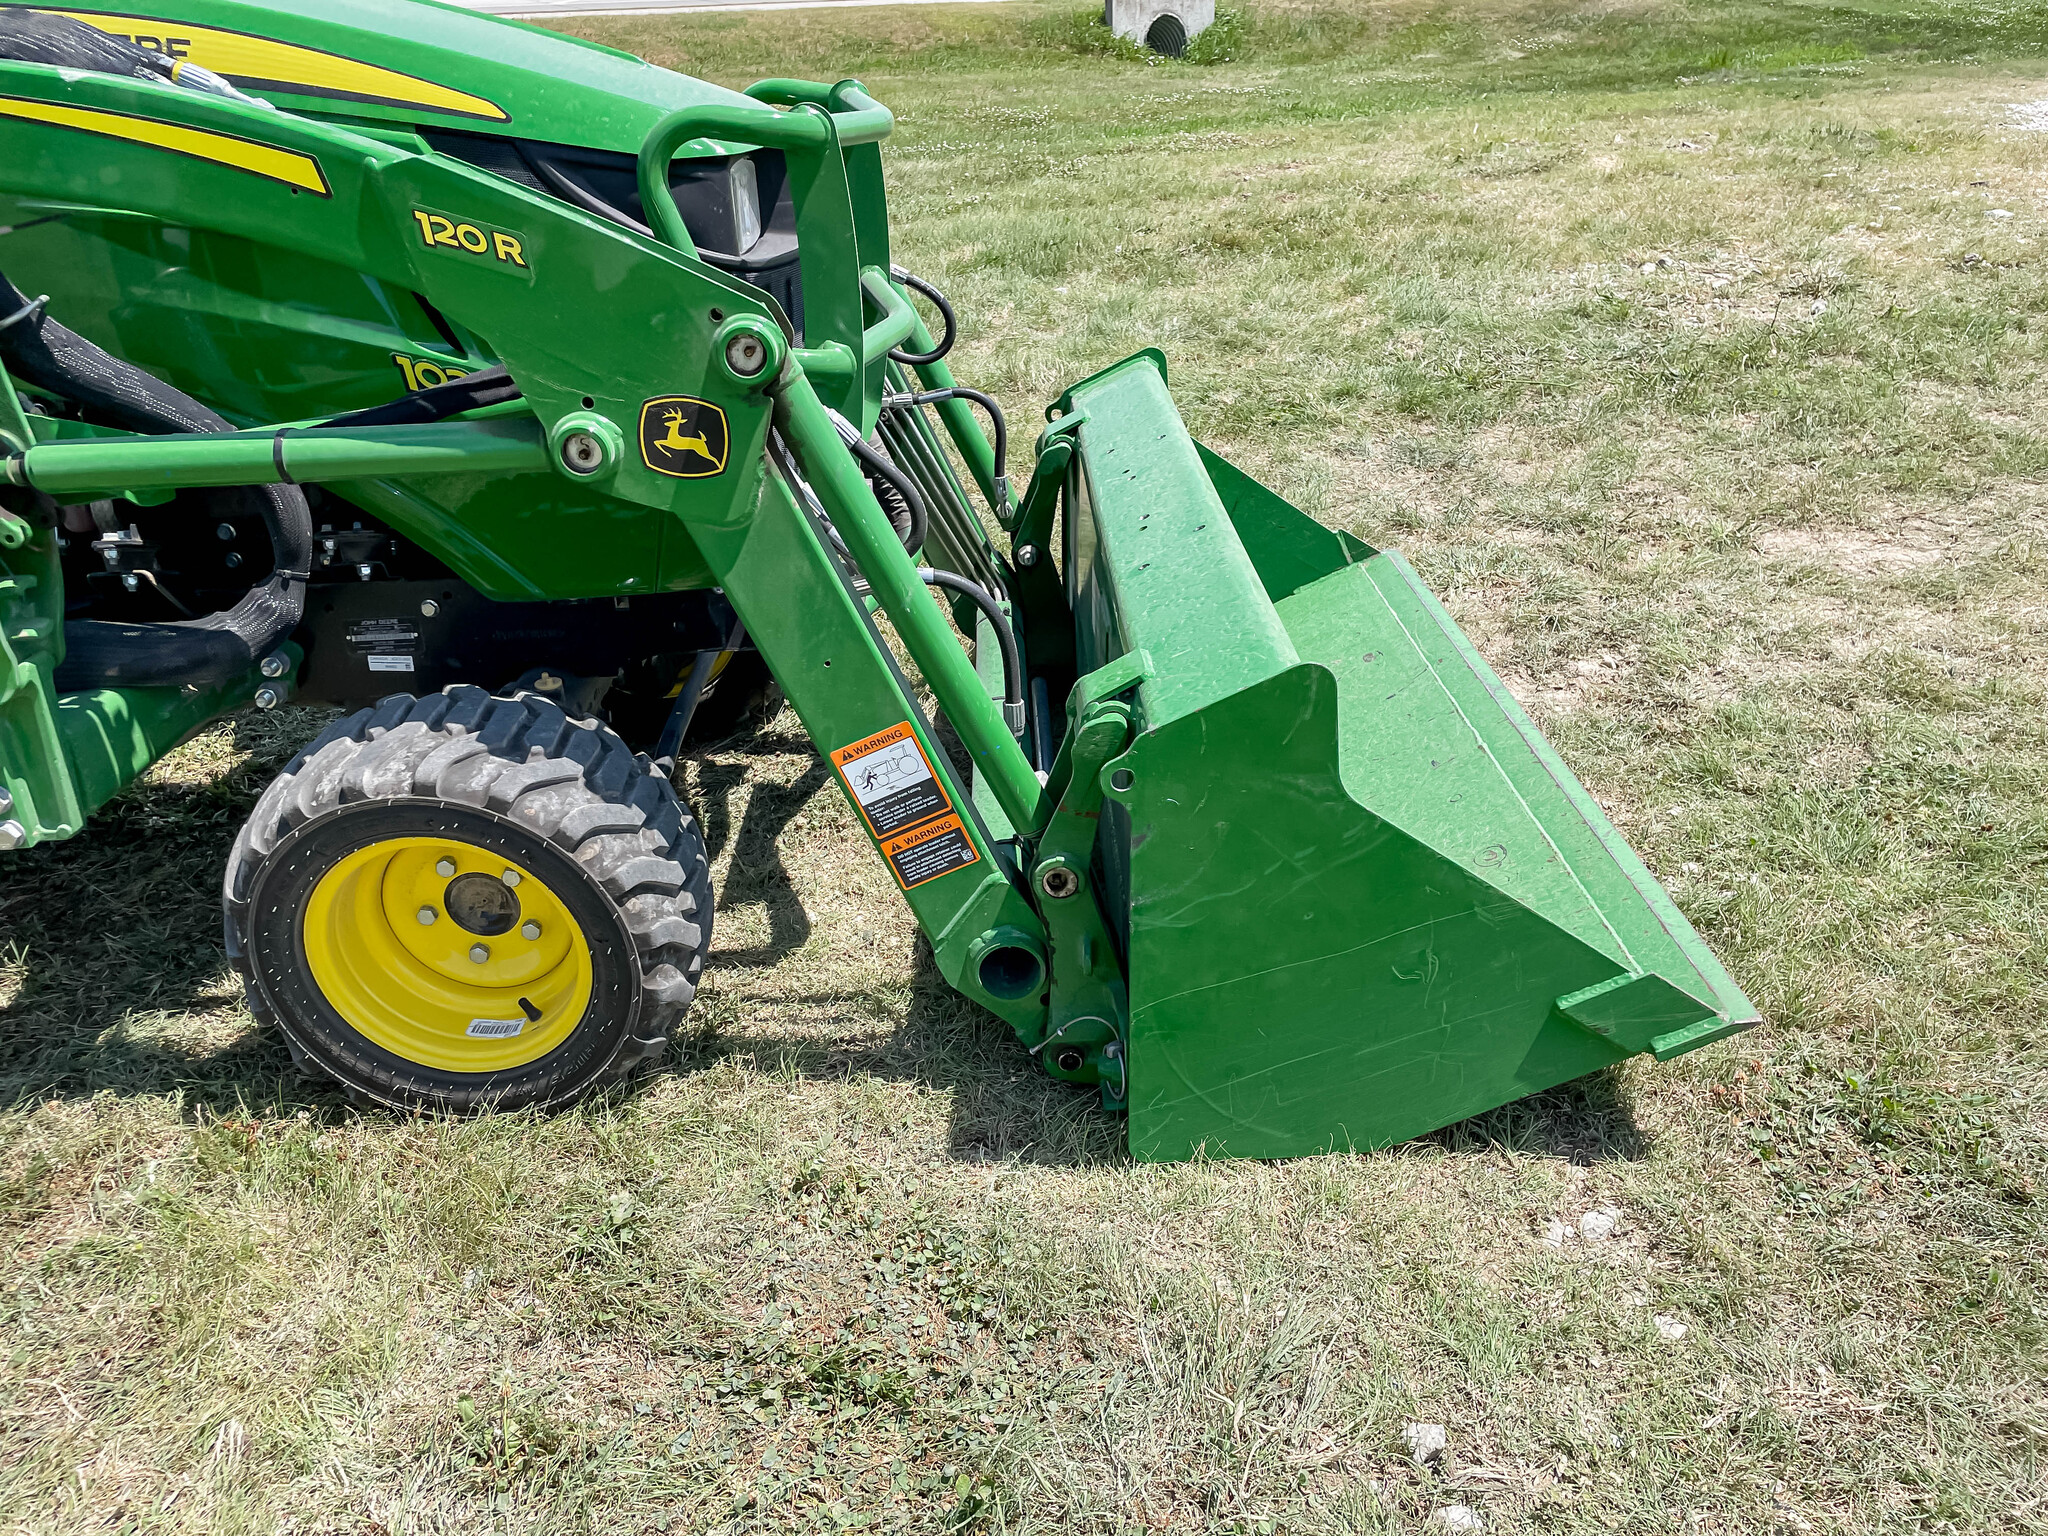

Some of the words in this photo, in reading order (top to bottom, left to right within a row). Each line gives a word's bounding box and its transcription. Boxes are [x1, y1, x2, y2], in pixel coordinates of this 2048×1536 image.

[412, 208, 489, 255] 120
[490, 230, 530, 269] R
[853, 730, 903, 755] WARNING
[906, 796, 922, 805] perform
[913, 804, 927, 812] ground
[904, 821, 952, 845] WARNING
